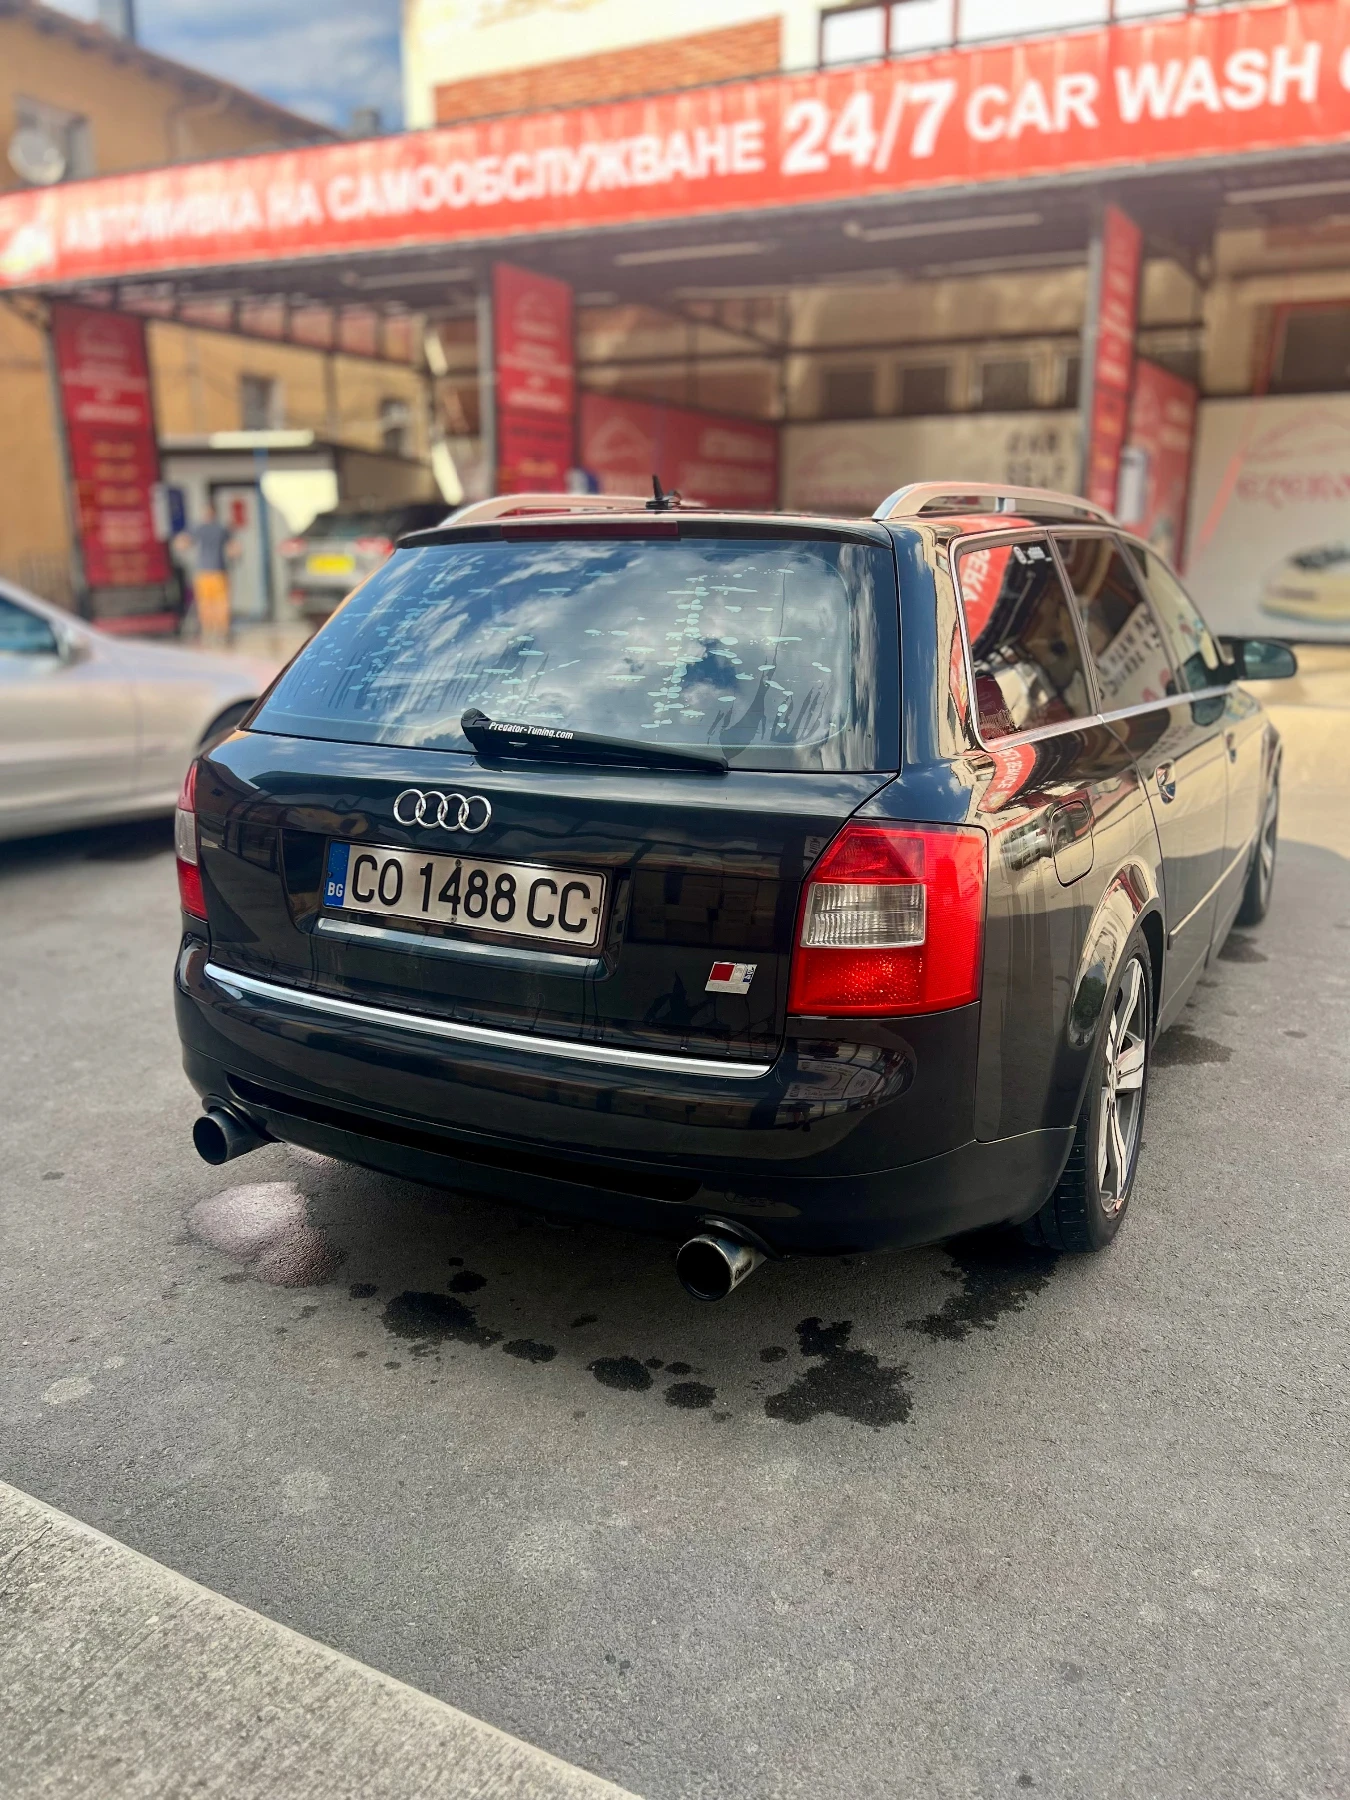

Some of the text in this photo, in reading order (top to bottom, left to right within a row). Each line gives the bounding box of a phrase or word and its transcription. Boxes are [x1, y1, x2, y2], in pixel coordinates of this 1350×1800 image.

[266, 177, 325, 231] НА
[779, 78, 957, 176] 24/7
[965, 71, 1100, 142] CAR
[1113, 40, 1322, 124] WASH
[488, 721, 574, 740] Predator-Tuning.com
[327, 881, 344, 898] BG
[351, 853, 592, 934] CO 1488 CC
